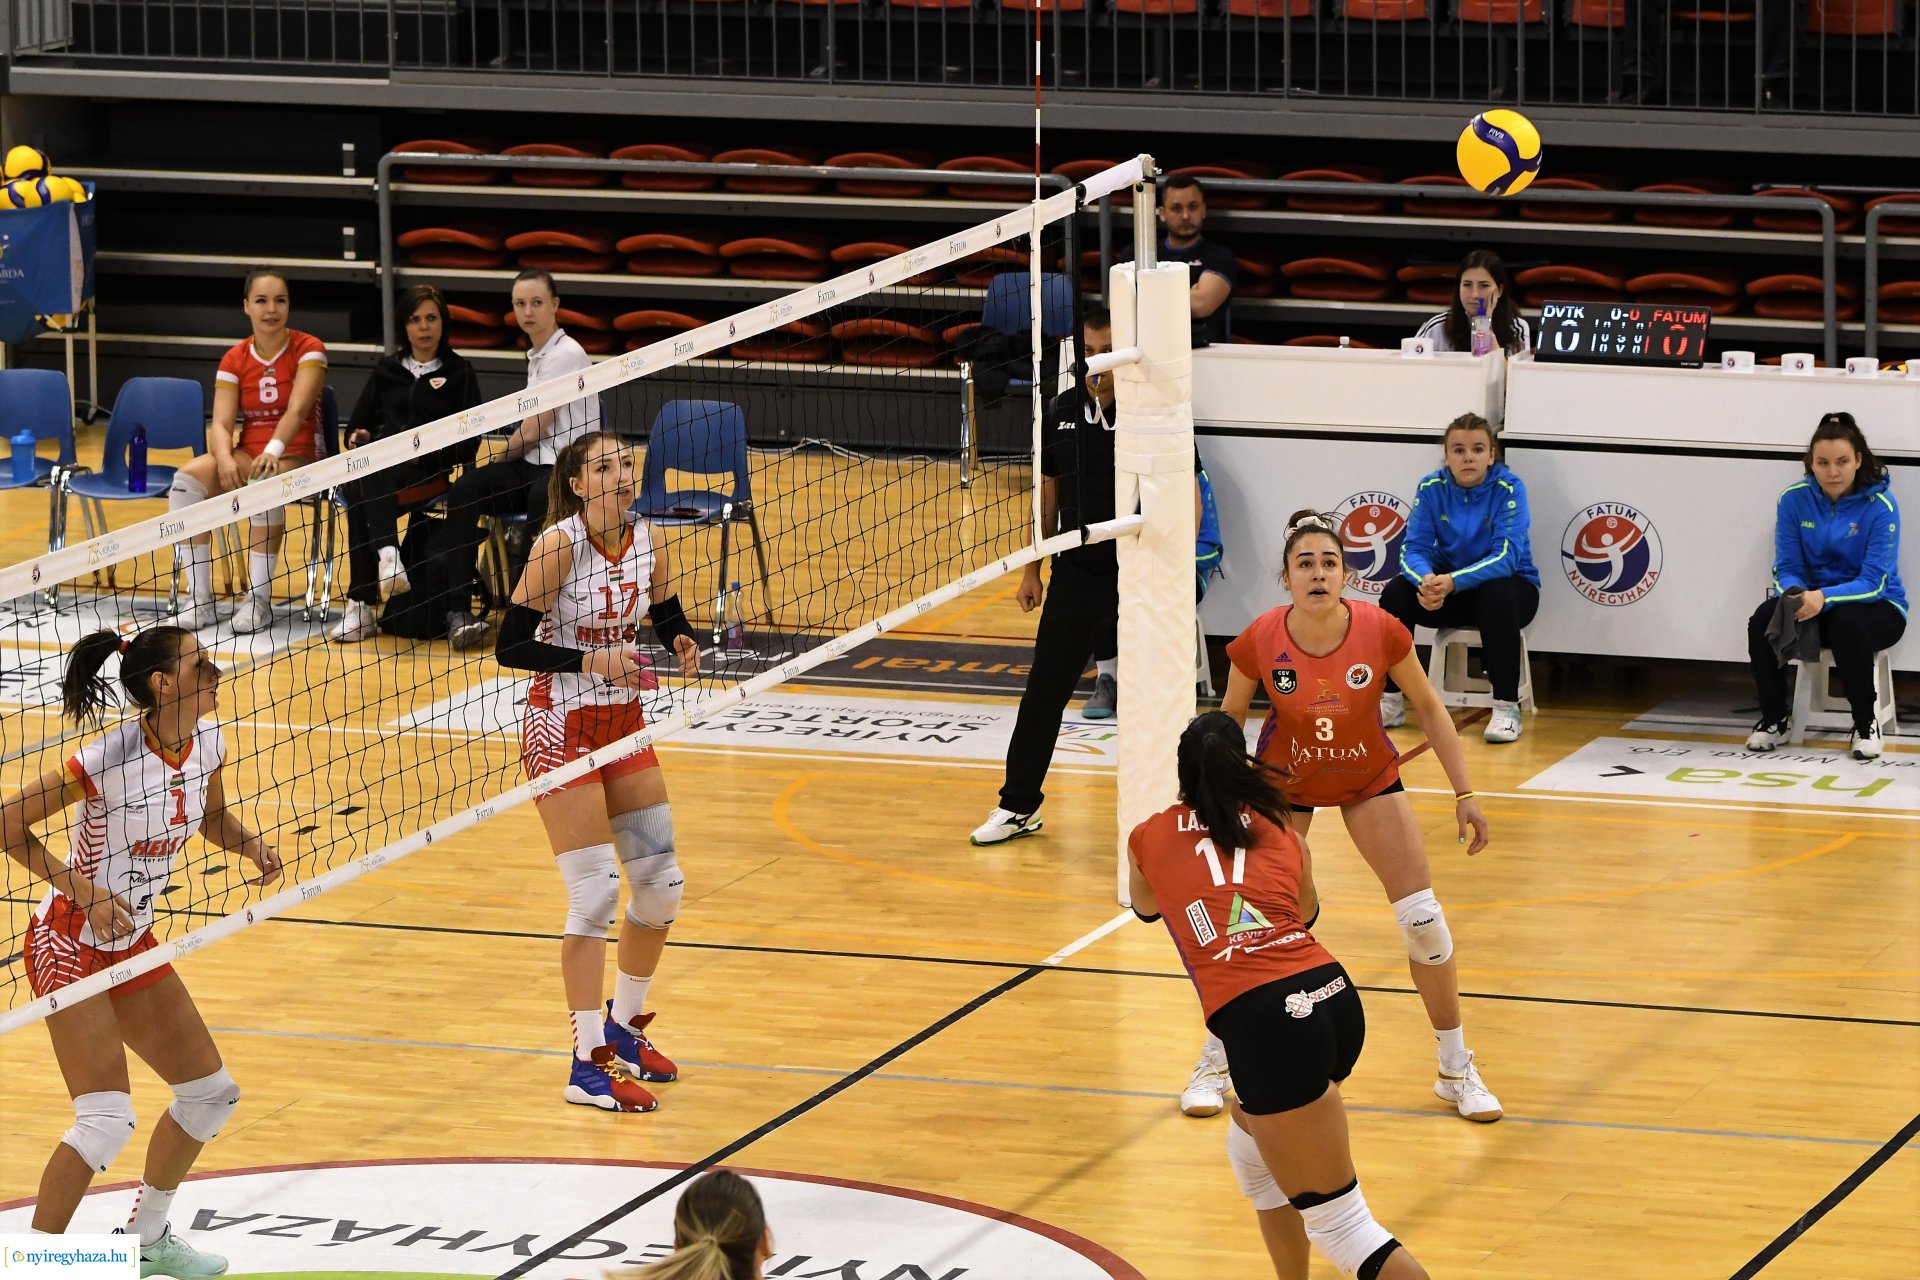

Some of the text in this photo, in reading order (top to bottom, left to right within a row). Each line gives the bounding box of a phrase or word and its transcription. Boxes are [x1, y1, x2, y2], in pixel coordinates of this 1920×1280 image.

[817, 289, 836, 304] FATUM
[1543, 305, 1585, 319] DVTK
[1653, 310, 1707, 324] FATUM
[673, 341, 694, 357] FATUM
[258, 376, 279, 404] 6
[517, 396, 539, 413] FATUM
[346, 456, 370, 474] FATUM
[1350, 493, 1400, 511] FATUM
[1586, 504, 1638, 521] FATUM
[160, 521, 185, 539] FATUM
[597, 582, 639, 620] 17
[1315, 717, 1334, 742] 3
[1665, 766, 1896, 798] hsa
[170, 788, 188, 826] 1
[301, 884, 322, 900] FATUM
[1191, 904, 1212, 941] STRABAG
[109, 968, 133, 985] FATUM
